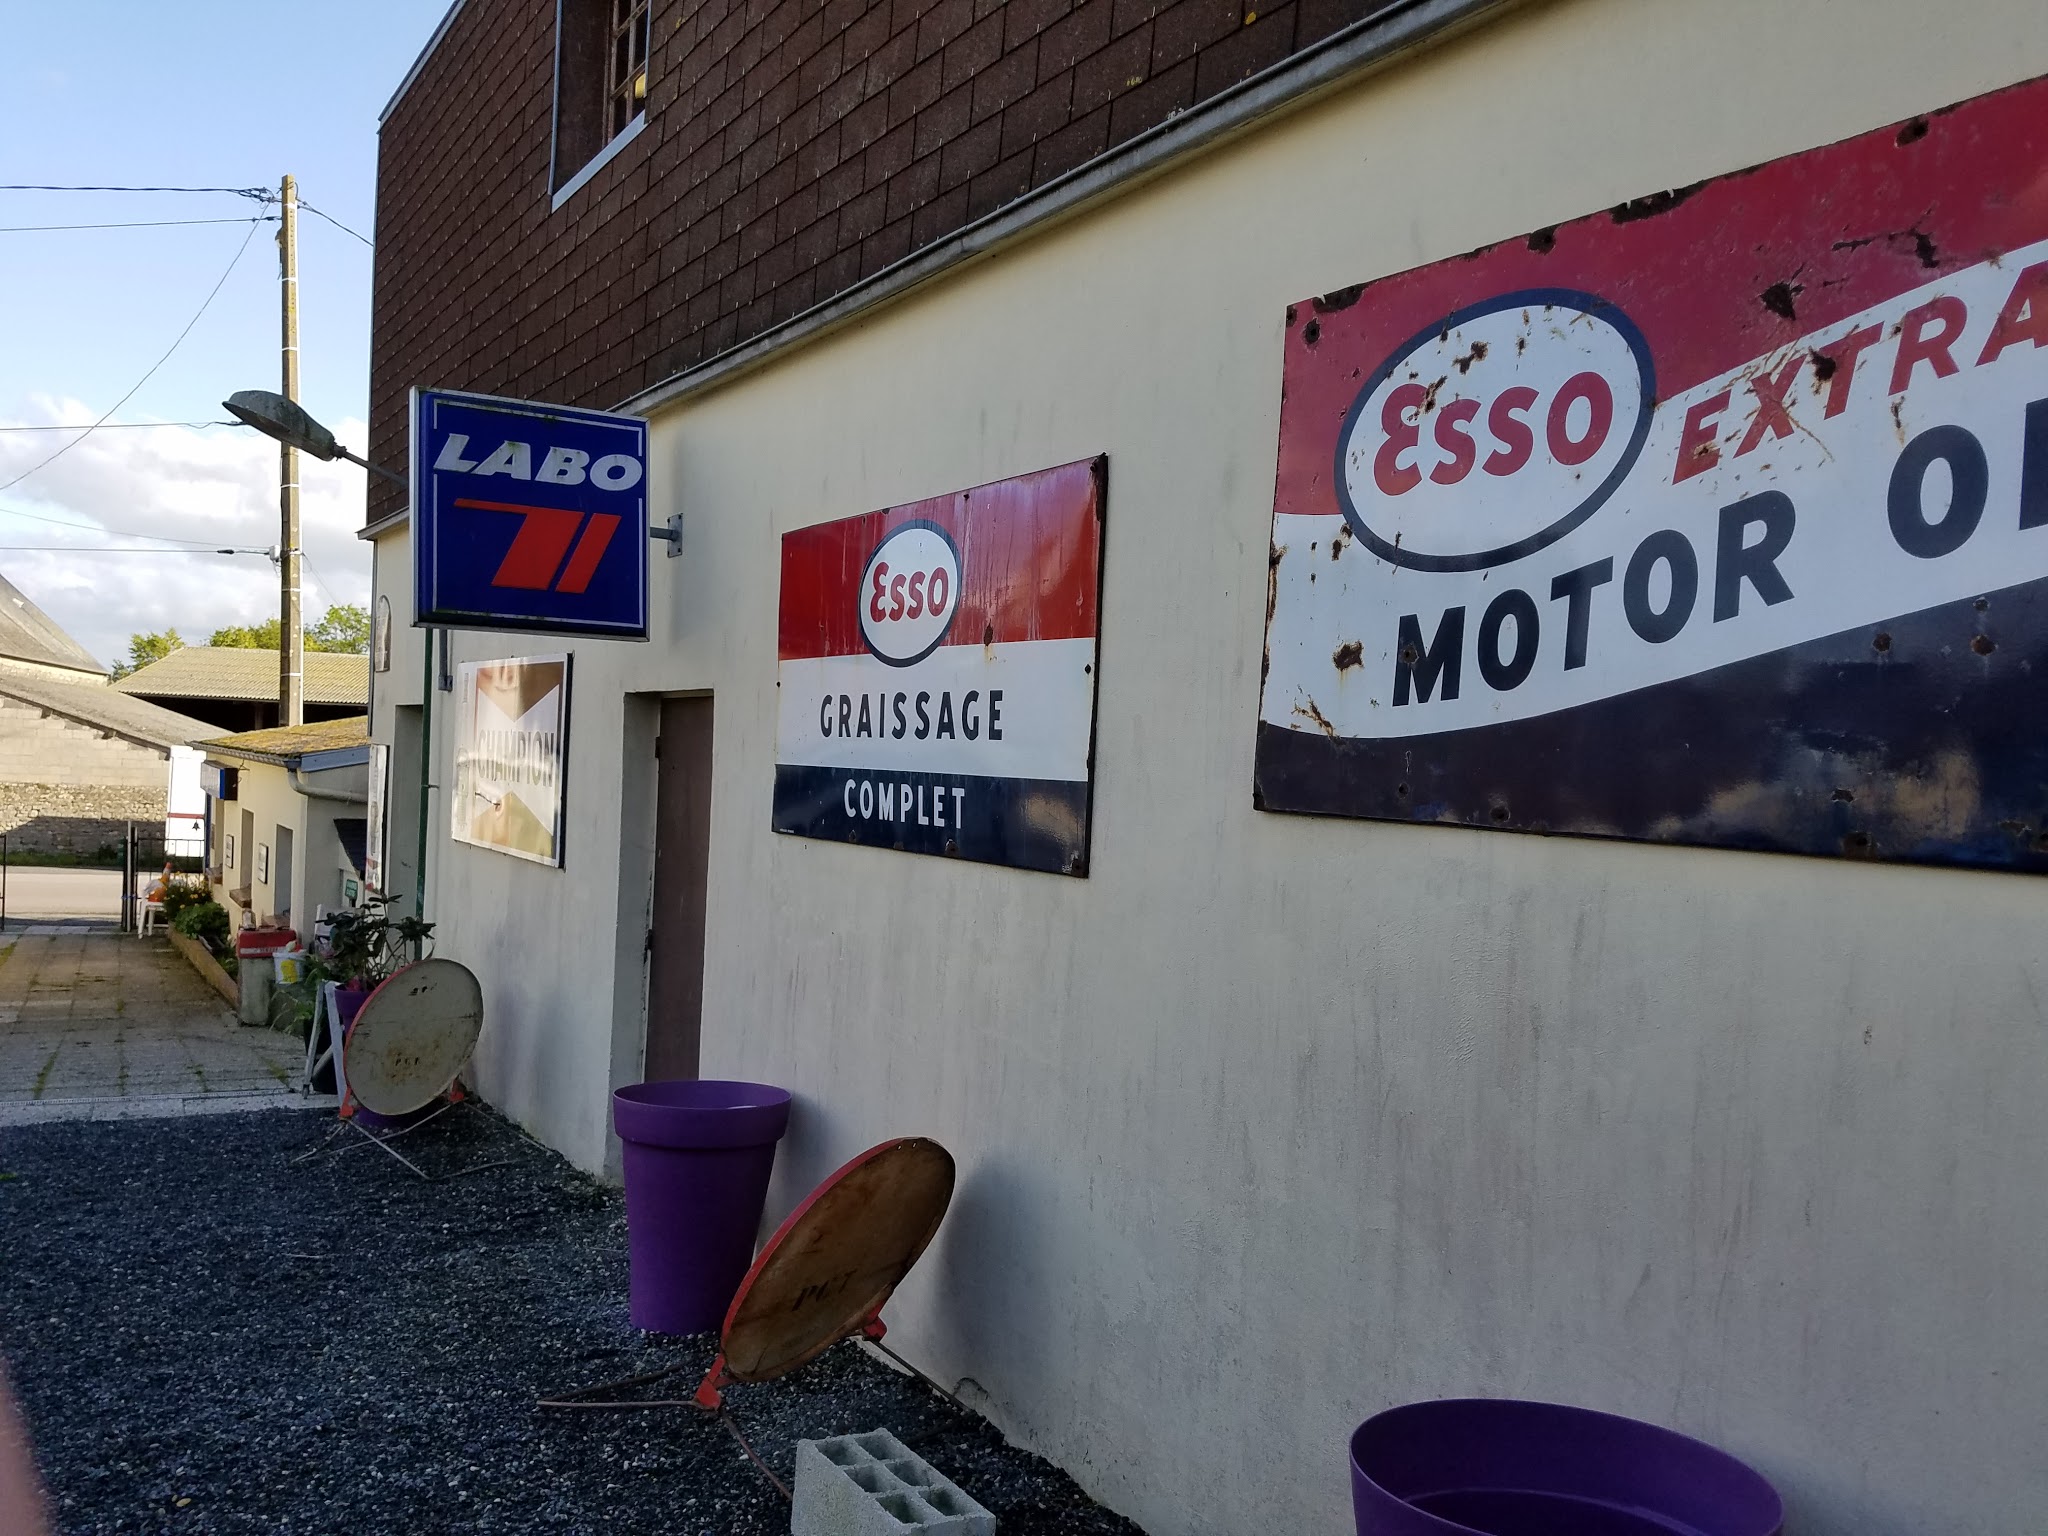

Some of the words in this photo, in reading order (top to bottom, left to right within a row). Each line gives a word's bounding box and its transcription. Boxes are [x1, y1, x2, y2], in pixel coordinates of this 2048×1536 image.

[1672, 259, 2048, 487] EXTRA
[433, 433, 643, 491] LABO
[1392, 489, 1796, 708] MOTOR
[820, 689, 1004, 741] GRAISSAGE
[478, 729, 554, 787] CHAMPION
[844, 778, 965, 830] COMPLET
